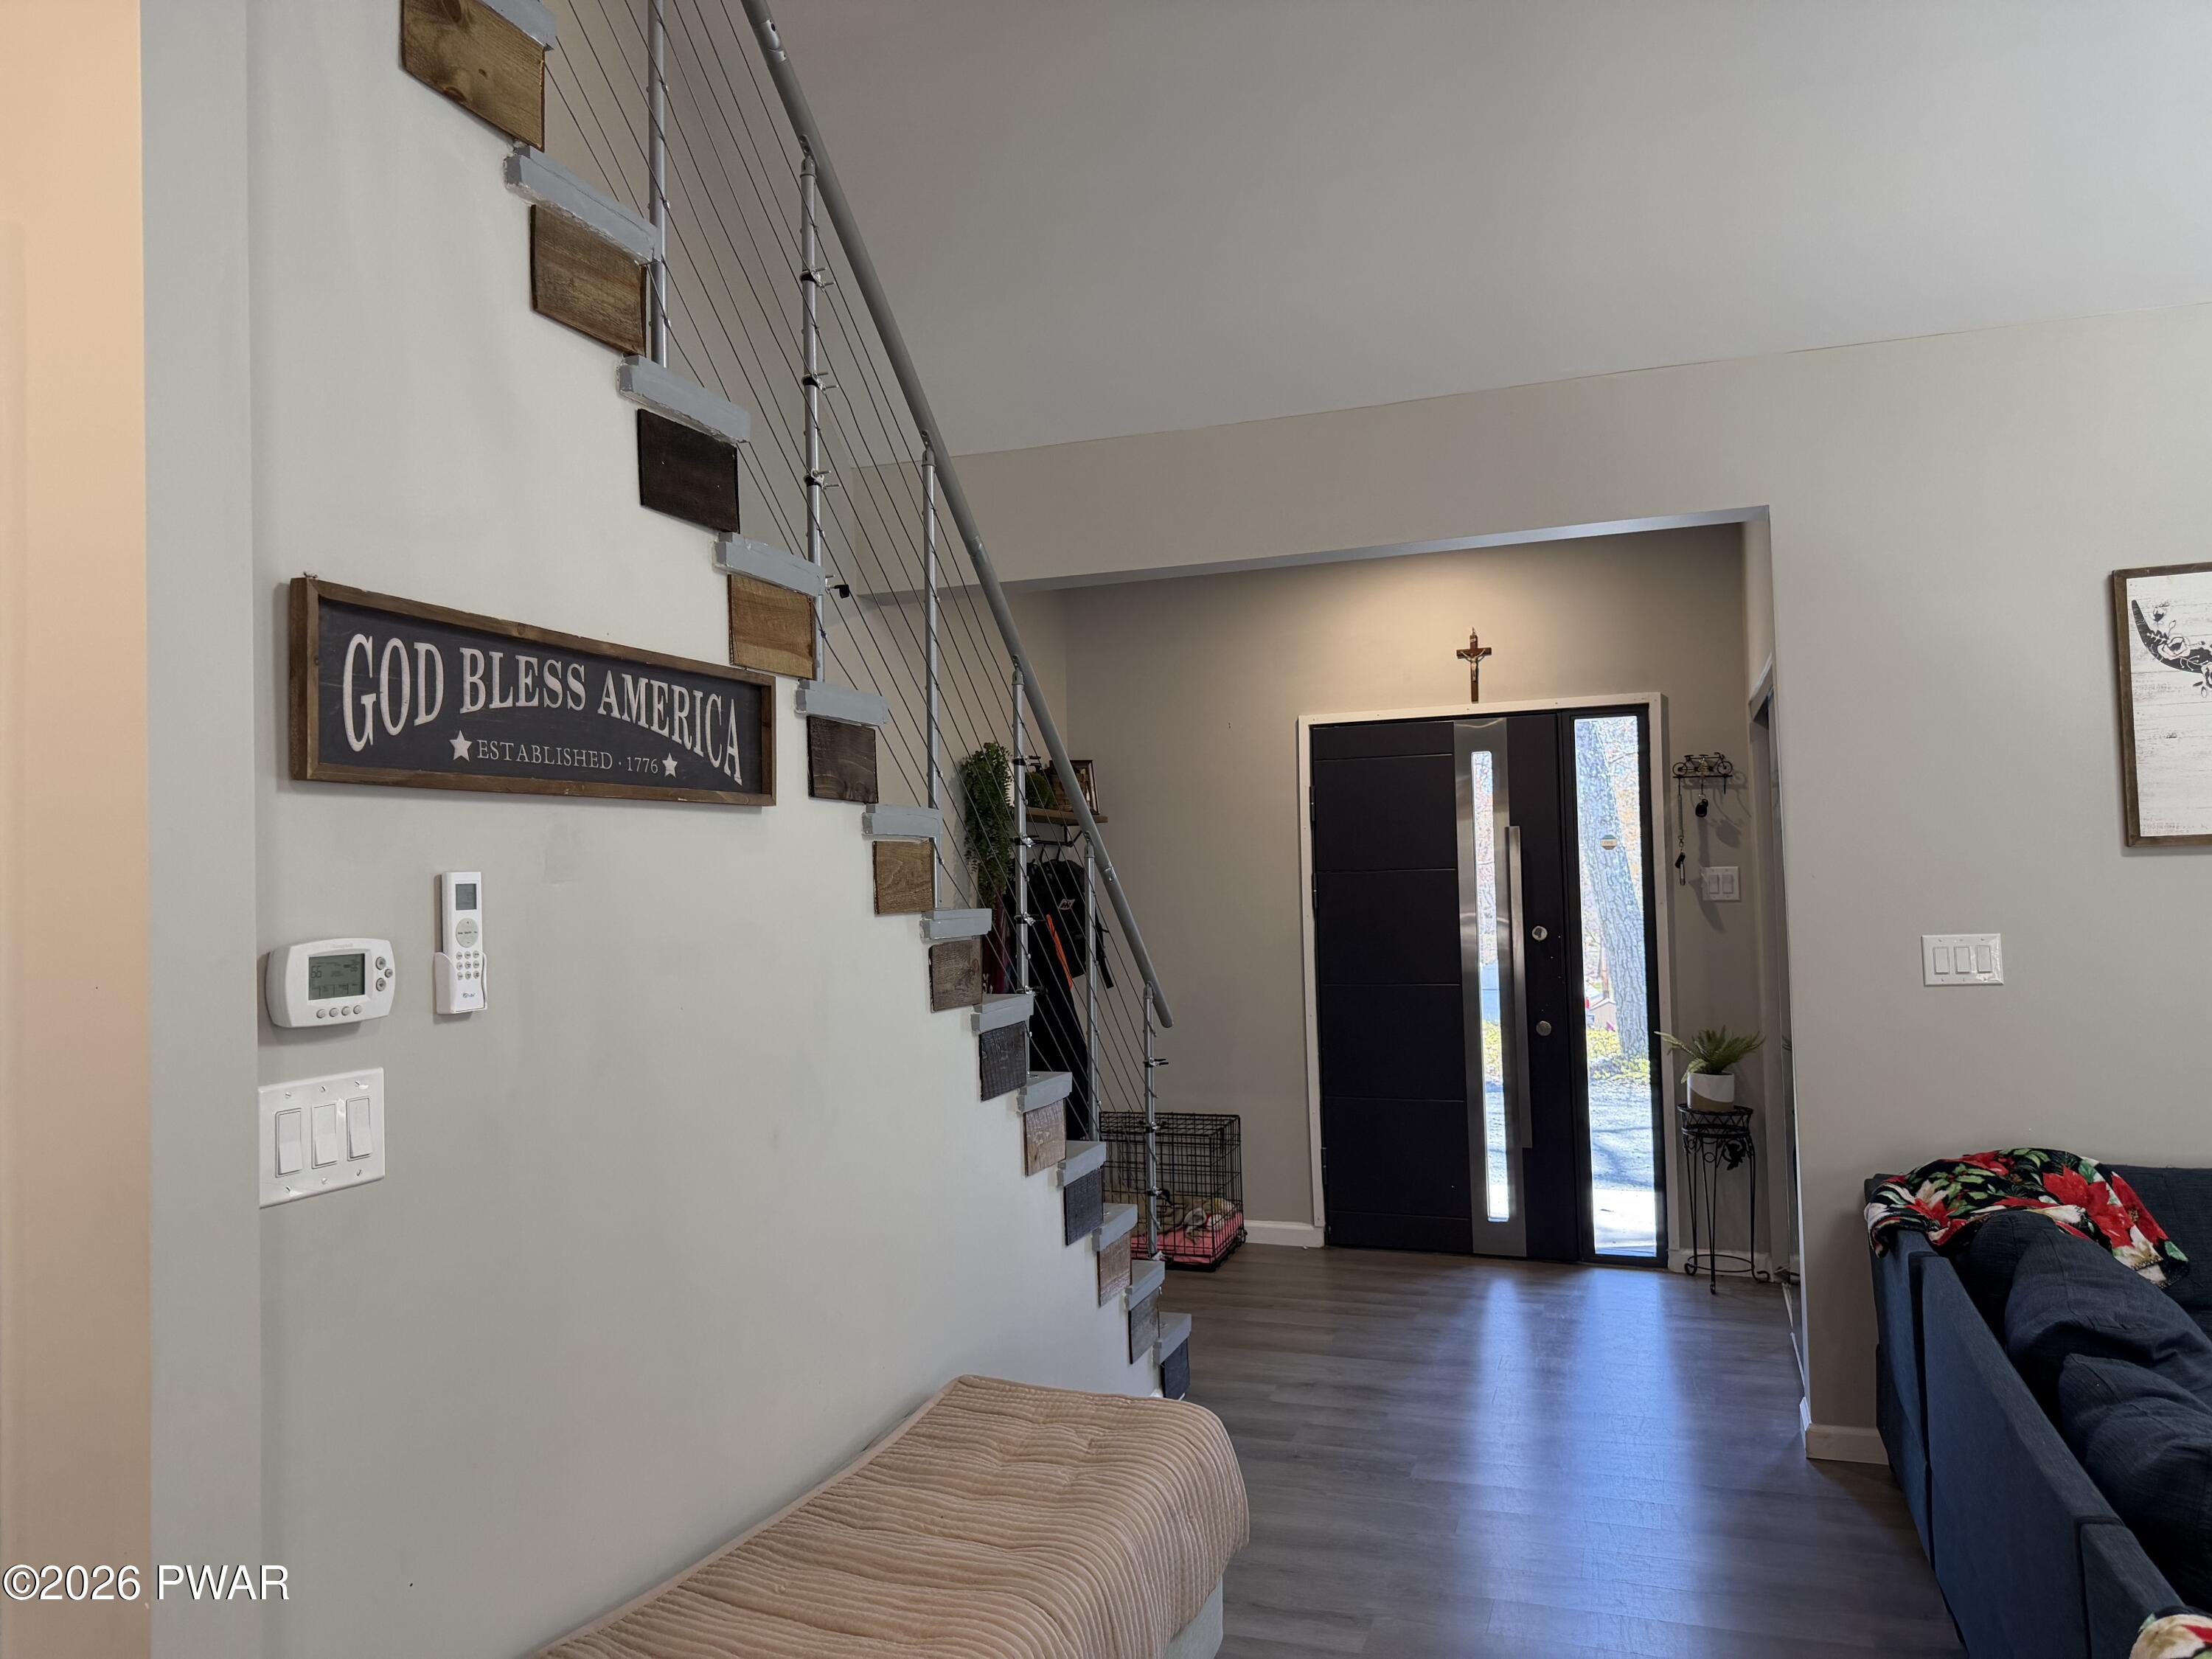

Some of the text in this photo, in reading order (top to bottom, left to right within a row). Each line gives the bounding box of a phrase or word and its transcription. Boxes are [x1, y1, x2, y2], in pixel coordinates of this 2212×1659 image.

[343, 633, 743, 787] GOD BLESS AMERICA
[476, 740, 659, 773] ESTABLISHED 1776
